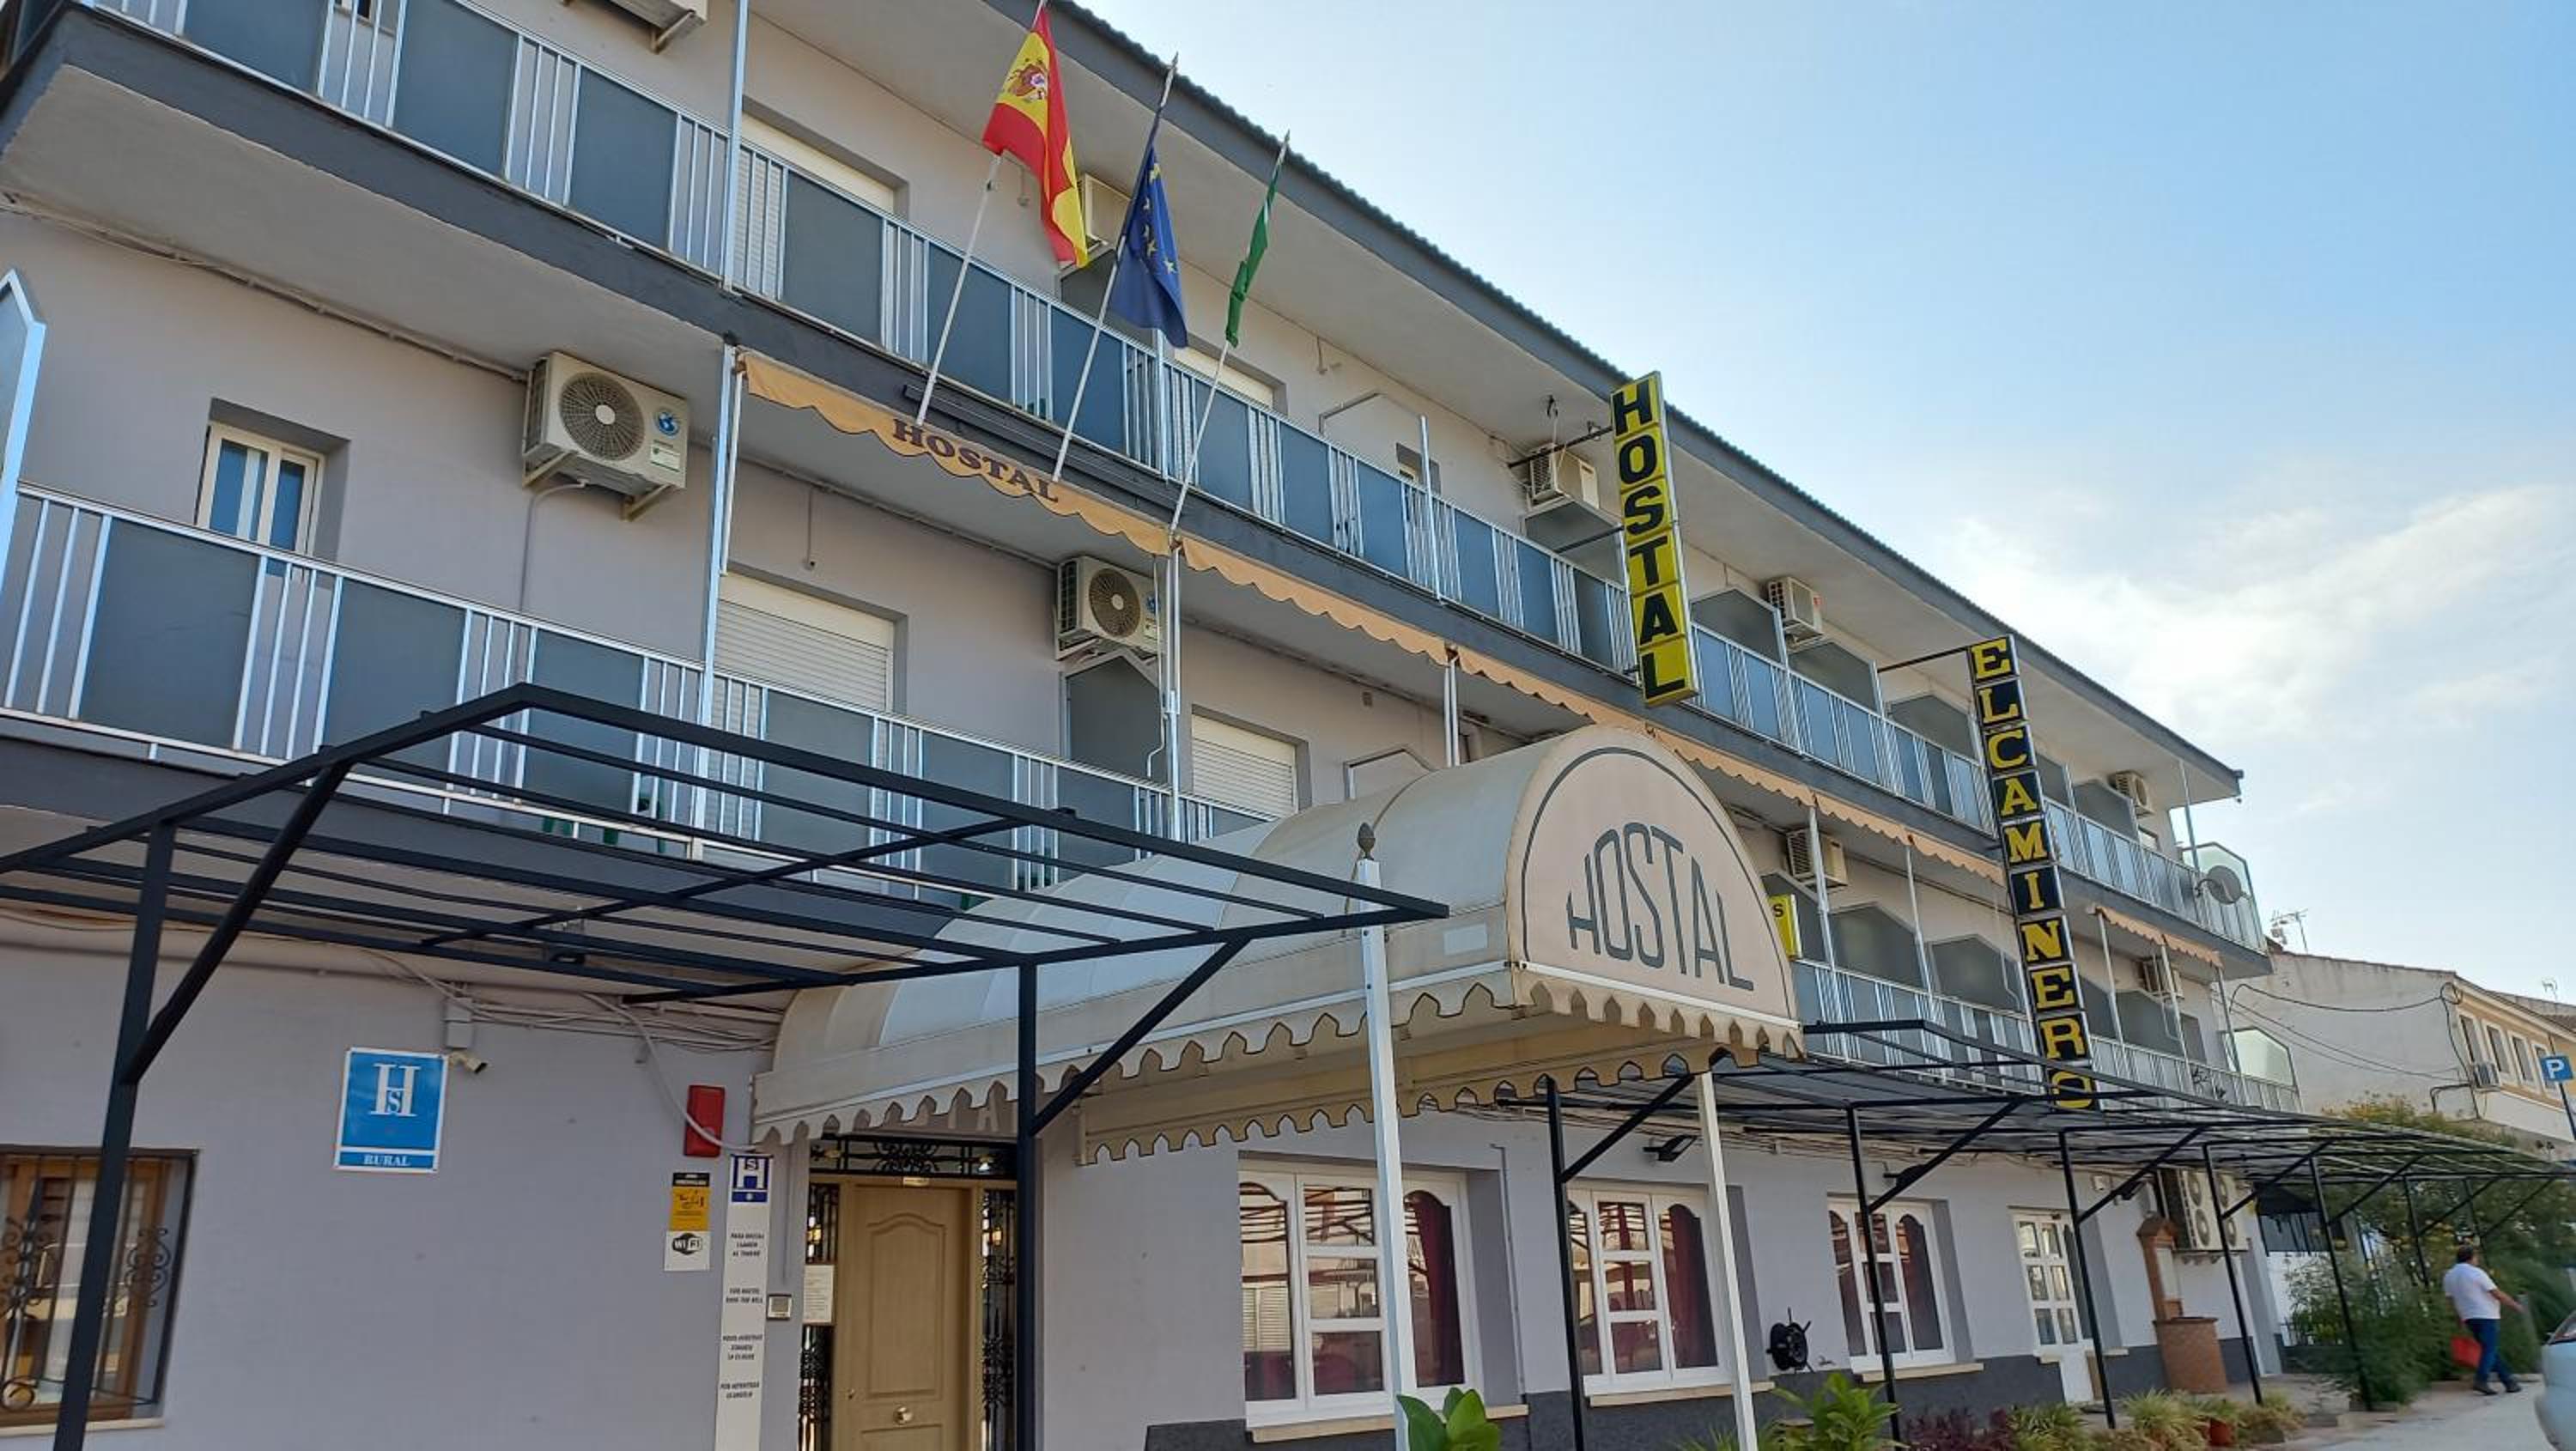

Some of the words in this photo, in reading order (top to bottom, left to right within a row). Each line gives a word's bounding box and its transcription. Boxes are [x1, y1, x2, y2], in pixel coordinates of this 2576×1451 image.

[892, 418, 1059, 503] HOSTAL
[1612, 379, 1686, 700] HOSTAL
[1565, 822, 1754, 992] HOSTAL
[2545, 1059, 2565, 1079] P
[363, 1155, 411, 1167] RURAL
